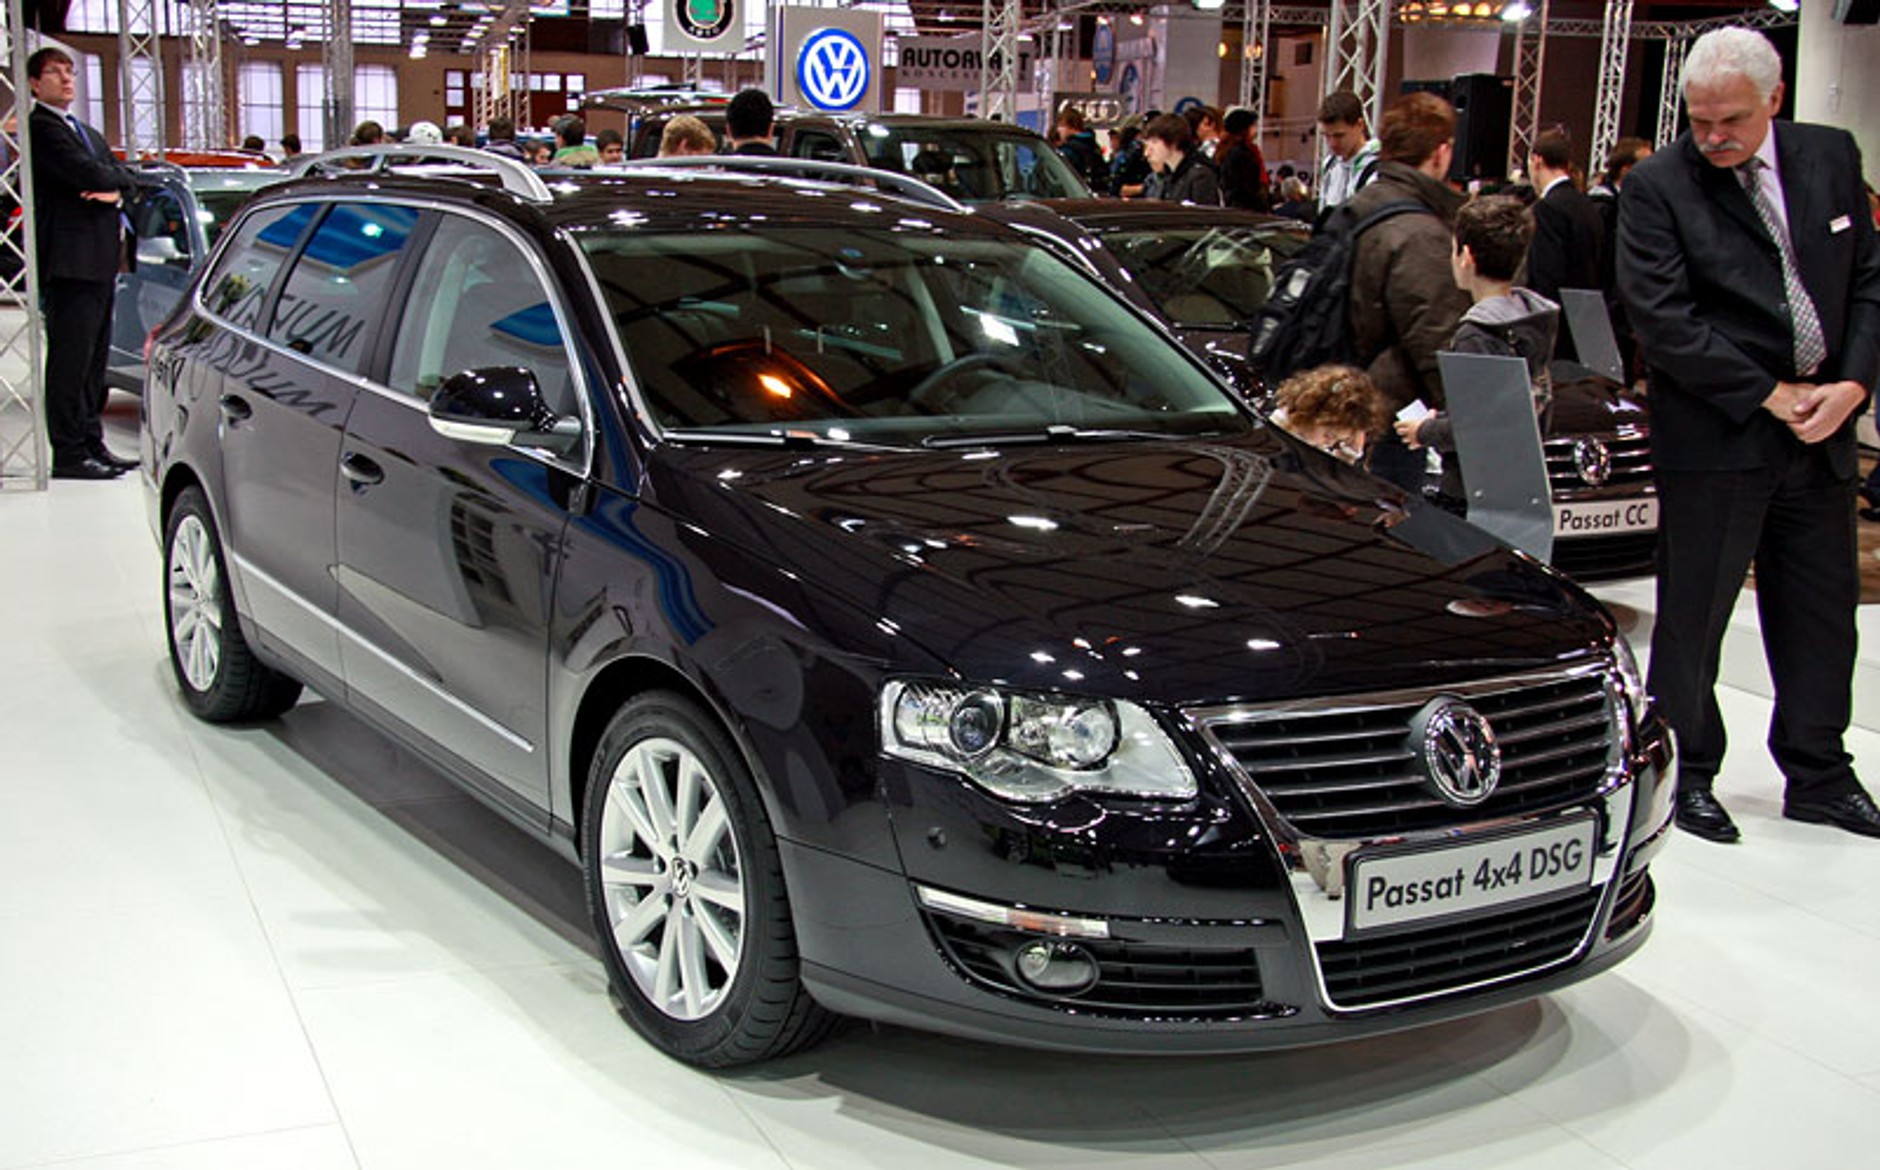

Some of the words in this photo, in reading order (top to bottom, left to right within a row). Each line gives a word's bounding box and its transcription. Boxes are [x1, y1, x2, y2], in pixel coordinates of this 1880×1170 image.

[1560, 509, 1620, 531] Passat
[1625, 503, 1649, 526] CC
[1366, 868, 1465, 911] Passat
[1473, 852, 1523, 892] 4x4
[1530, 838, 1583, 881] DSG
